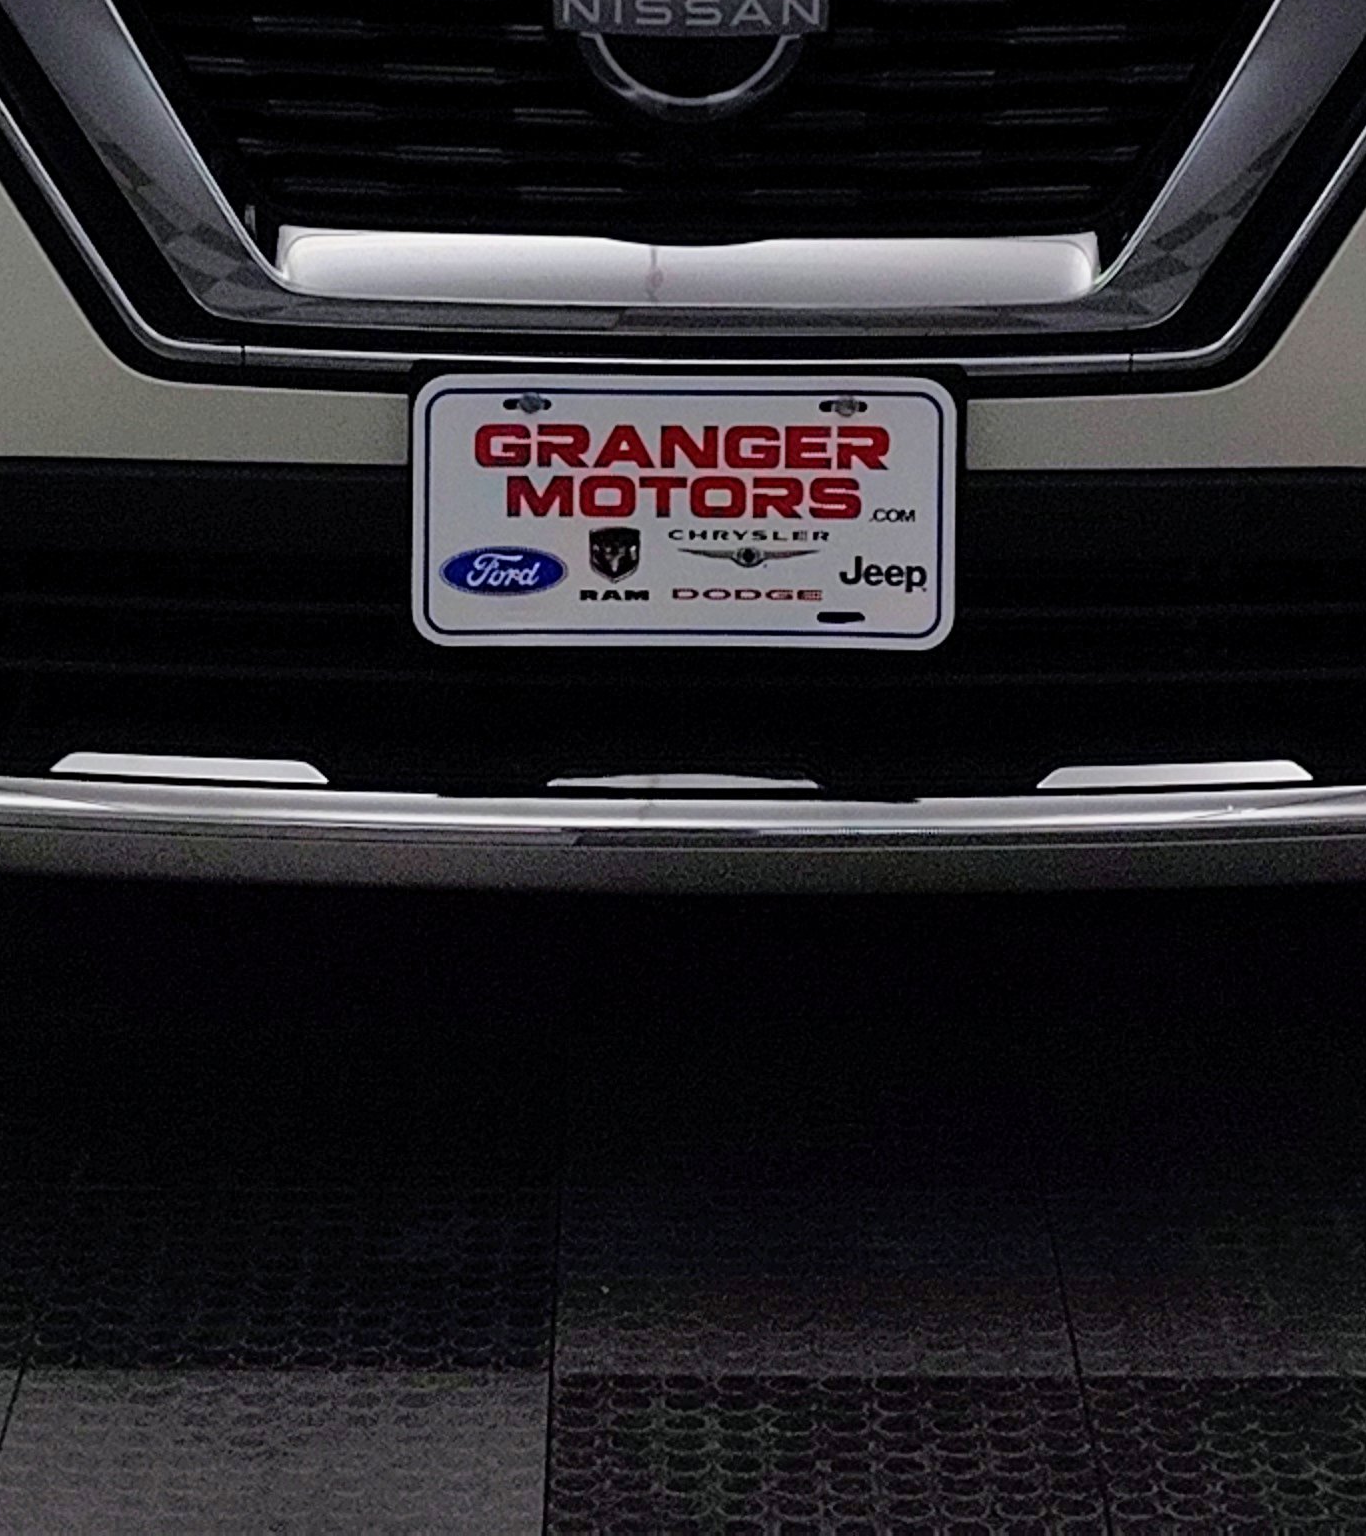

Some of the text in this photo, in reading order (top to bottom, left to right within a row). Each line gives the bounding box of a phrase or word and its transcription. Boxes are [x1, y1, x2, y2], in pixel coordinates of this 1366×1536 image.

[474, 424, 890, 469] GRANGER
[506, 476, 916, 522] MOTORS .COM
[667, 529, 830, 542] CHRYSLER
[466, 553, 540, 588] Ford
[840, 556, 927, 593] Jeep
[580, 589, 649, 601] RAM
[672, 588, 823, 601] DODGE
